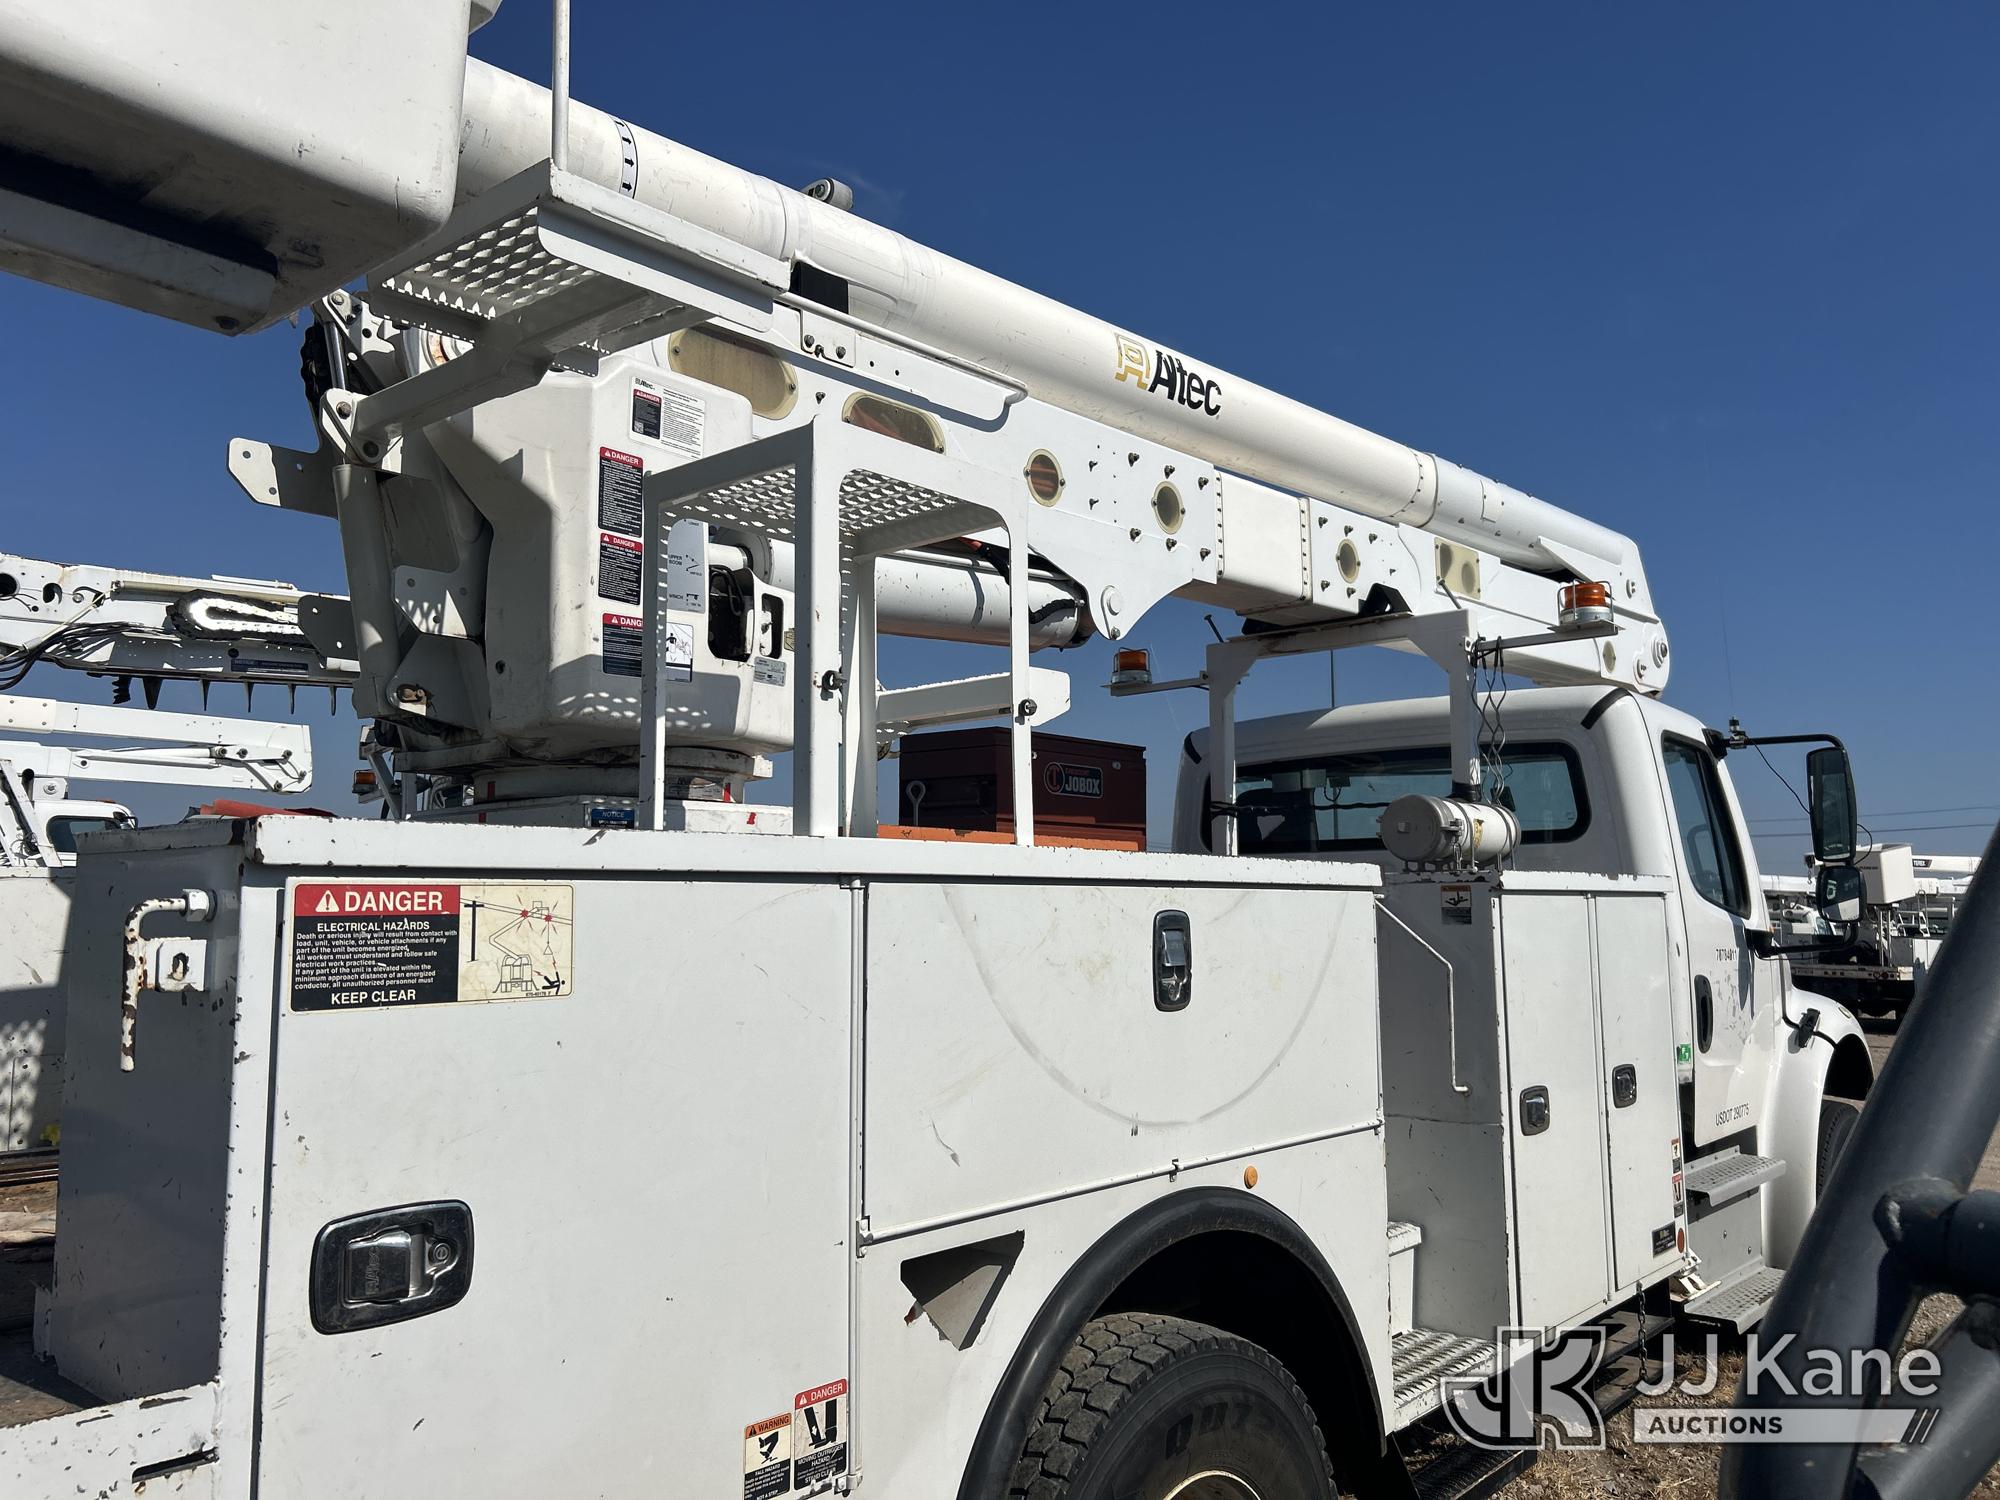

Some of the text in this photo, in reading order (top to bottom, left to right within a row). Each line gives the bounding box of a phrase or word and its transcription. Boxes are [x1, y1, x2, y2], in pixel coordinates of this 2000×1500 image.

[1148, 350, 1222, 416] Altec
[611, 451, 639, 465] DANGER
[612, 538, 636, 548] DANGER
[1065, 776, 1100, 794] JOBOX
[344, 890, 443, 912] DANGER
[317, 920, 430, 932] ELECTRICAL HAZARDS
[296, 932, 316, 940] Death
[332, 938, 356, 946] vehicle,
[406, 970, 436, 978] energized
[294, 982, 331, 990] conductor,
[342, 979, 384, 987] unauthorized
[386, 978, 417, 986] personnel
[331, 990, 416, 1005] KEEP CLEAR
[1716, 1108, 1732, 1126] USDOT
[810, 1382, 844, 1401] DANGER
[758, 1416, 790, 1432] WARNING
[798, 1454, 817, 1465] MOVING
[811, 1456, 830, 1467] HAZARD
[754, 1464, 781, 1476] FALL HAZARD
